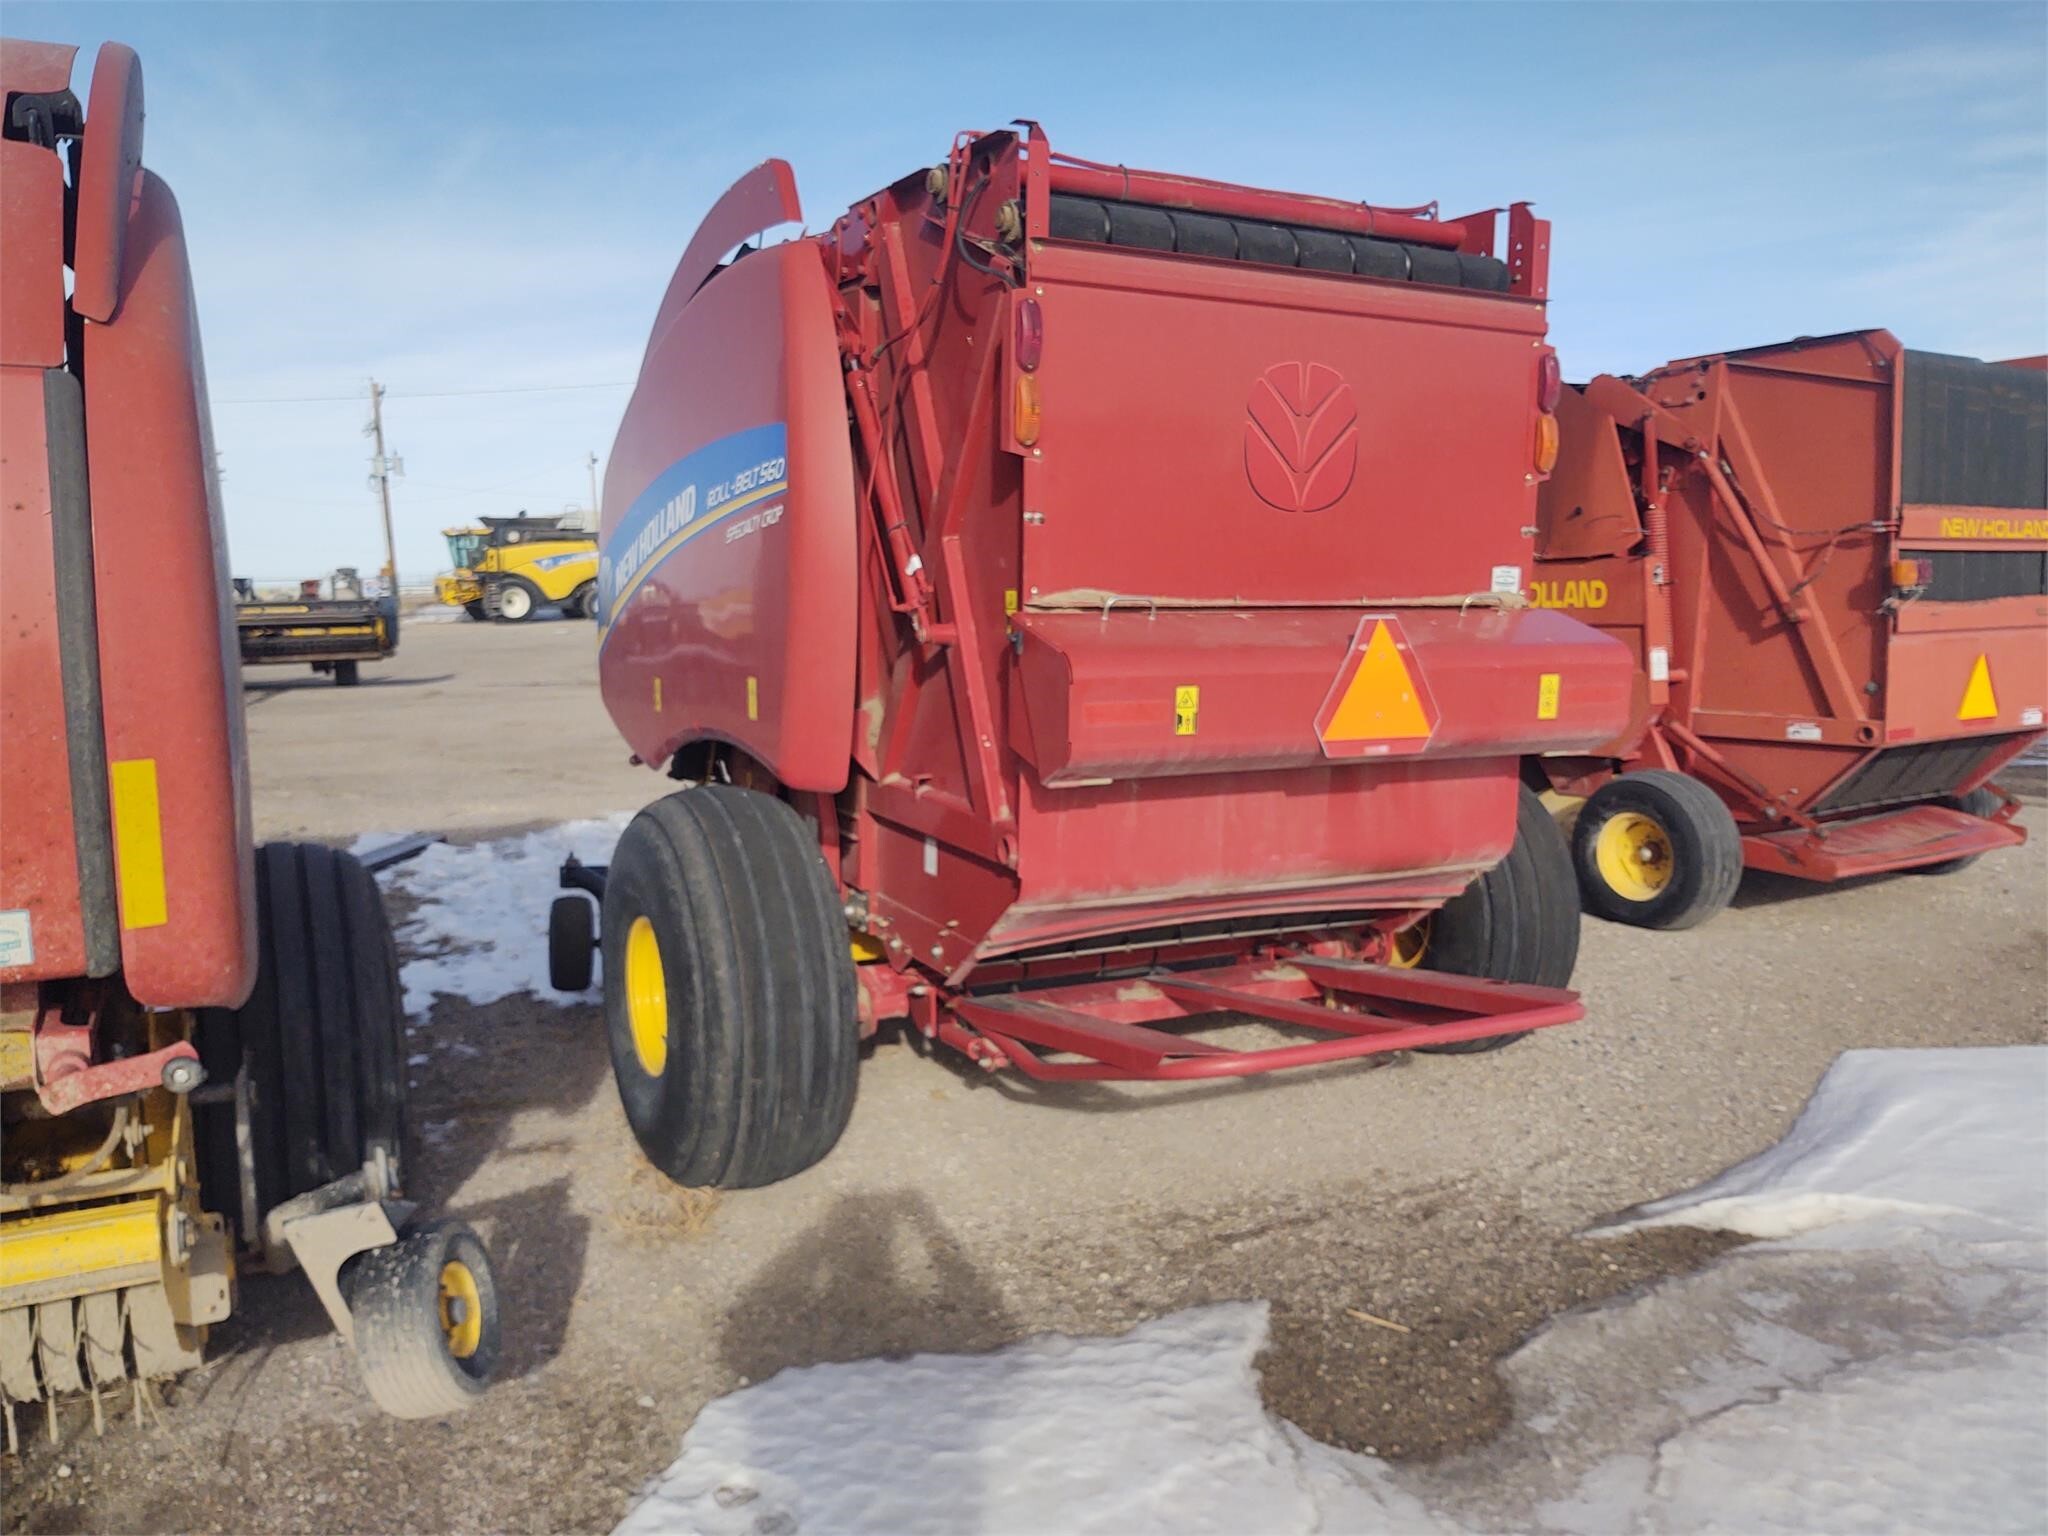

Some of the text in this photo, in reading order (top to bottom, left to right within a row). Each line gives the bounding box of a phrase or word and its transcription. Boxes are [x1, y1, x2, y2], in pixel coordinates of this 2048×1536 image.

[759, 457, 786, 485] 560
[615, 484, 697, 598] NEW HOLLAND
[1940, 517, 1980, 539] NEW
[1528, 579, 1609, 609] OLLAND
